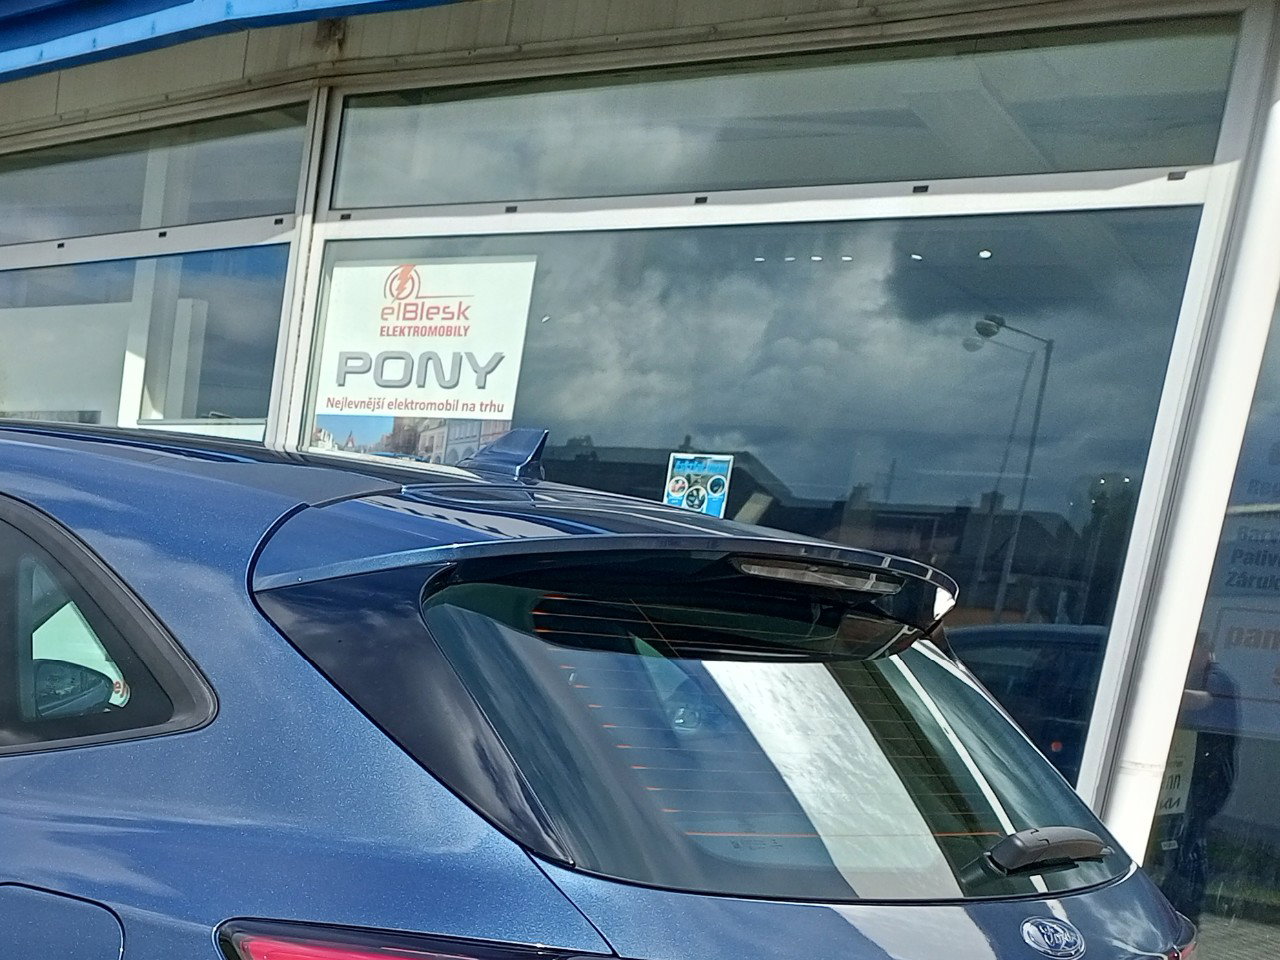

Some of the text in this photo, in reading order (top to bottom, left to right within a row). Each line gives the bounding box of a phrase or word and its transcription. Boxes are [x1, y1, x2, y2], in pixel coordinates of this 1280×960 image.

[379, 325, 470, 338] ELEKTROMOBILY
[336, 350, 506, 390] PONY
[326, 397, 505, 413] Nejlevnější elektromobil na trhu
